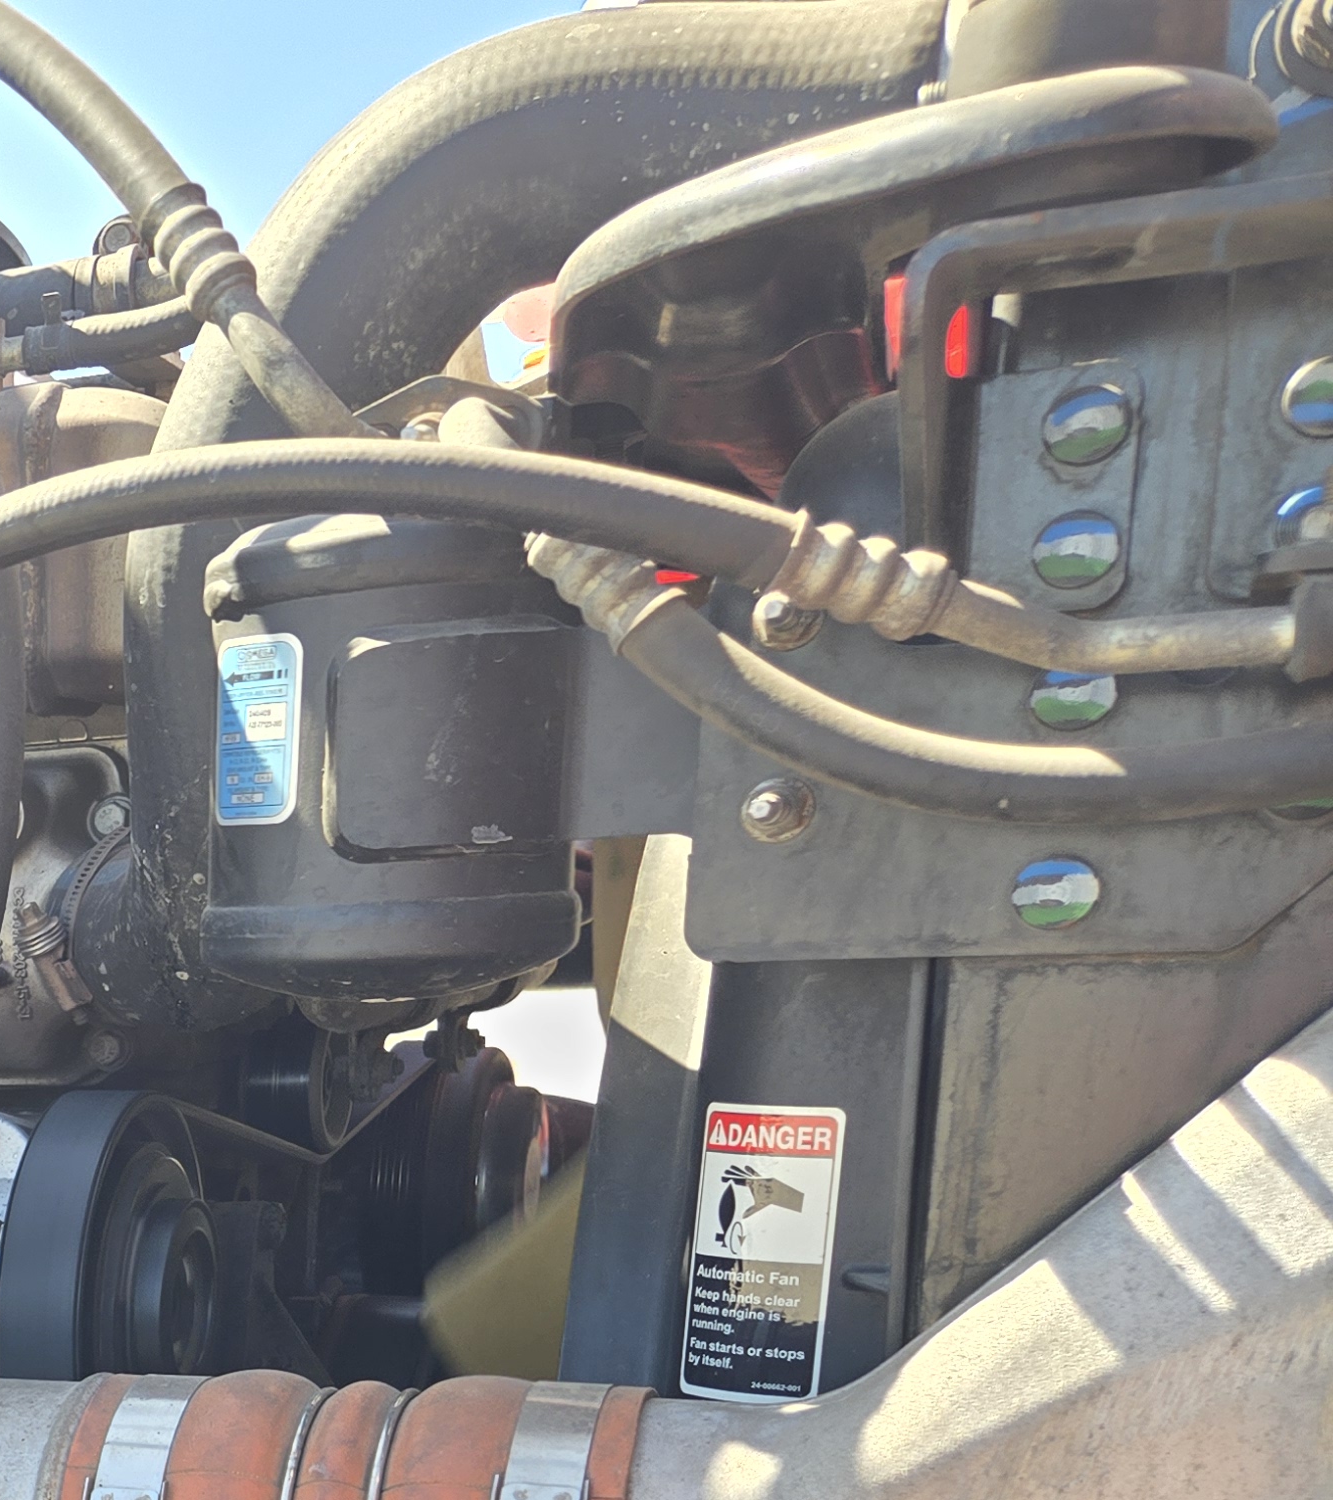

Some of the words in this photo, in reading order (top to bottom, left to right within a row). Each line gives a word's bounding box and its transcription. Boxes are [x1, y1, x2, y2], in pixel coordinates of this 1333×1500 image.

[727, 1123, 832, 1151] DANGER
[696, 1263, 765, 1284] Automatic
[769, 1272, 800, 1287] Fan
[694, 1286, 720, 1302] Keep
[722, 1290, 761, 1306] hands
[764, 1296, 801, 1308] clear
[693, 1302, 720, 1316] when
[721, 1308, 765, 1321] engine
[768, 1310, 781, 1322] is
[691, 1318, 735, 1335] running.
[690, 1336, 707, 1351] Fan
[708, 1340, 744, 1355] starts
[747, 1346, 763, 1357] or
[765, 1346, 806, 1362] stops
[688, 1352, 701, 1366] by
[702, 1354, 733, 1369] itself.
